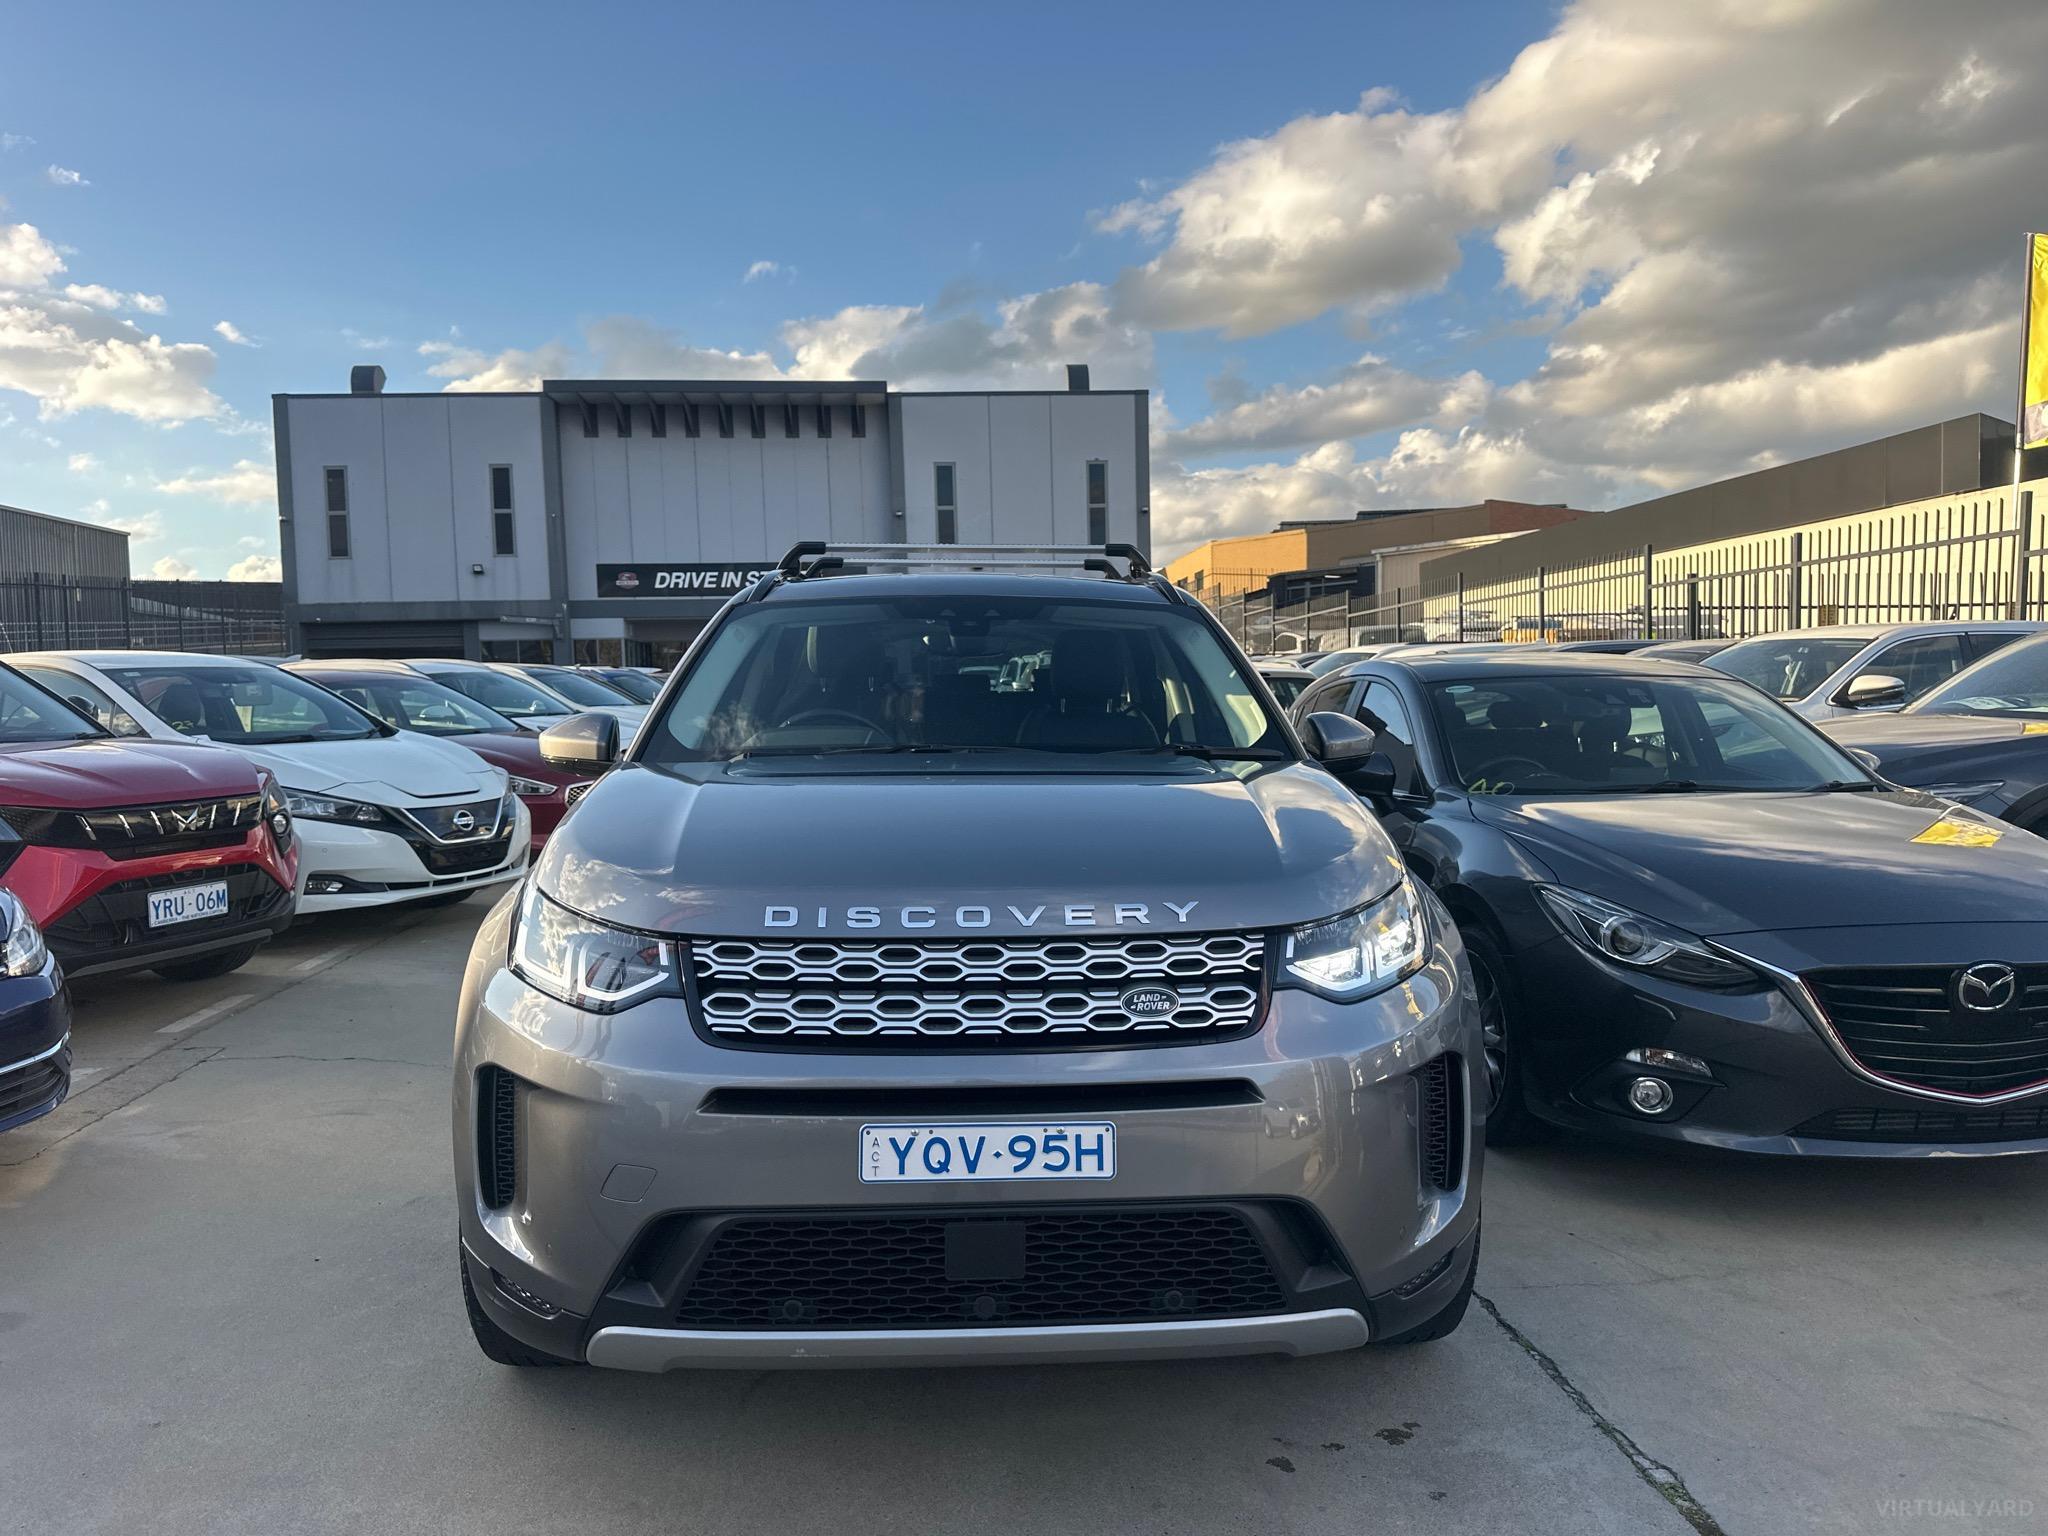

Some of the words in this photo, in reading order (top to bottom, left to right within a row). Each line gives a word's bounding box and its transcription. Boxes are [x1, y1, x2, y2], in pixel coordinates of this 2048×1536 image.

[654, 571, 718, 589] DRIVE
[720, 571, 742, 588] IN
[764, 901, 1199, 928] DISCOVERY
[1133, 993, 1161, 1003] LAND
[1136, 1001, 1170, 1011] ROVER
